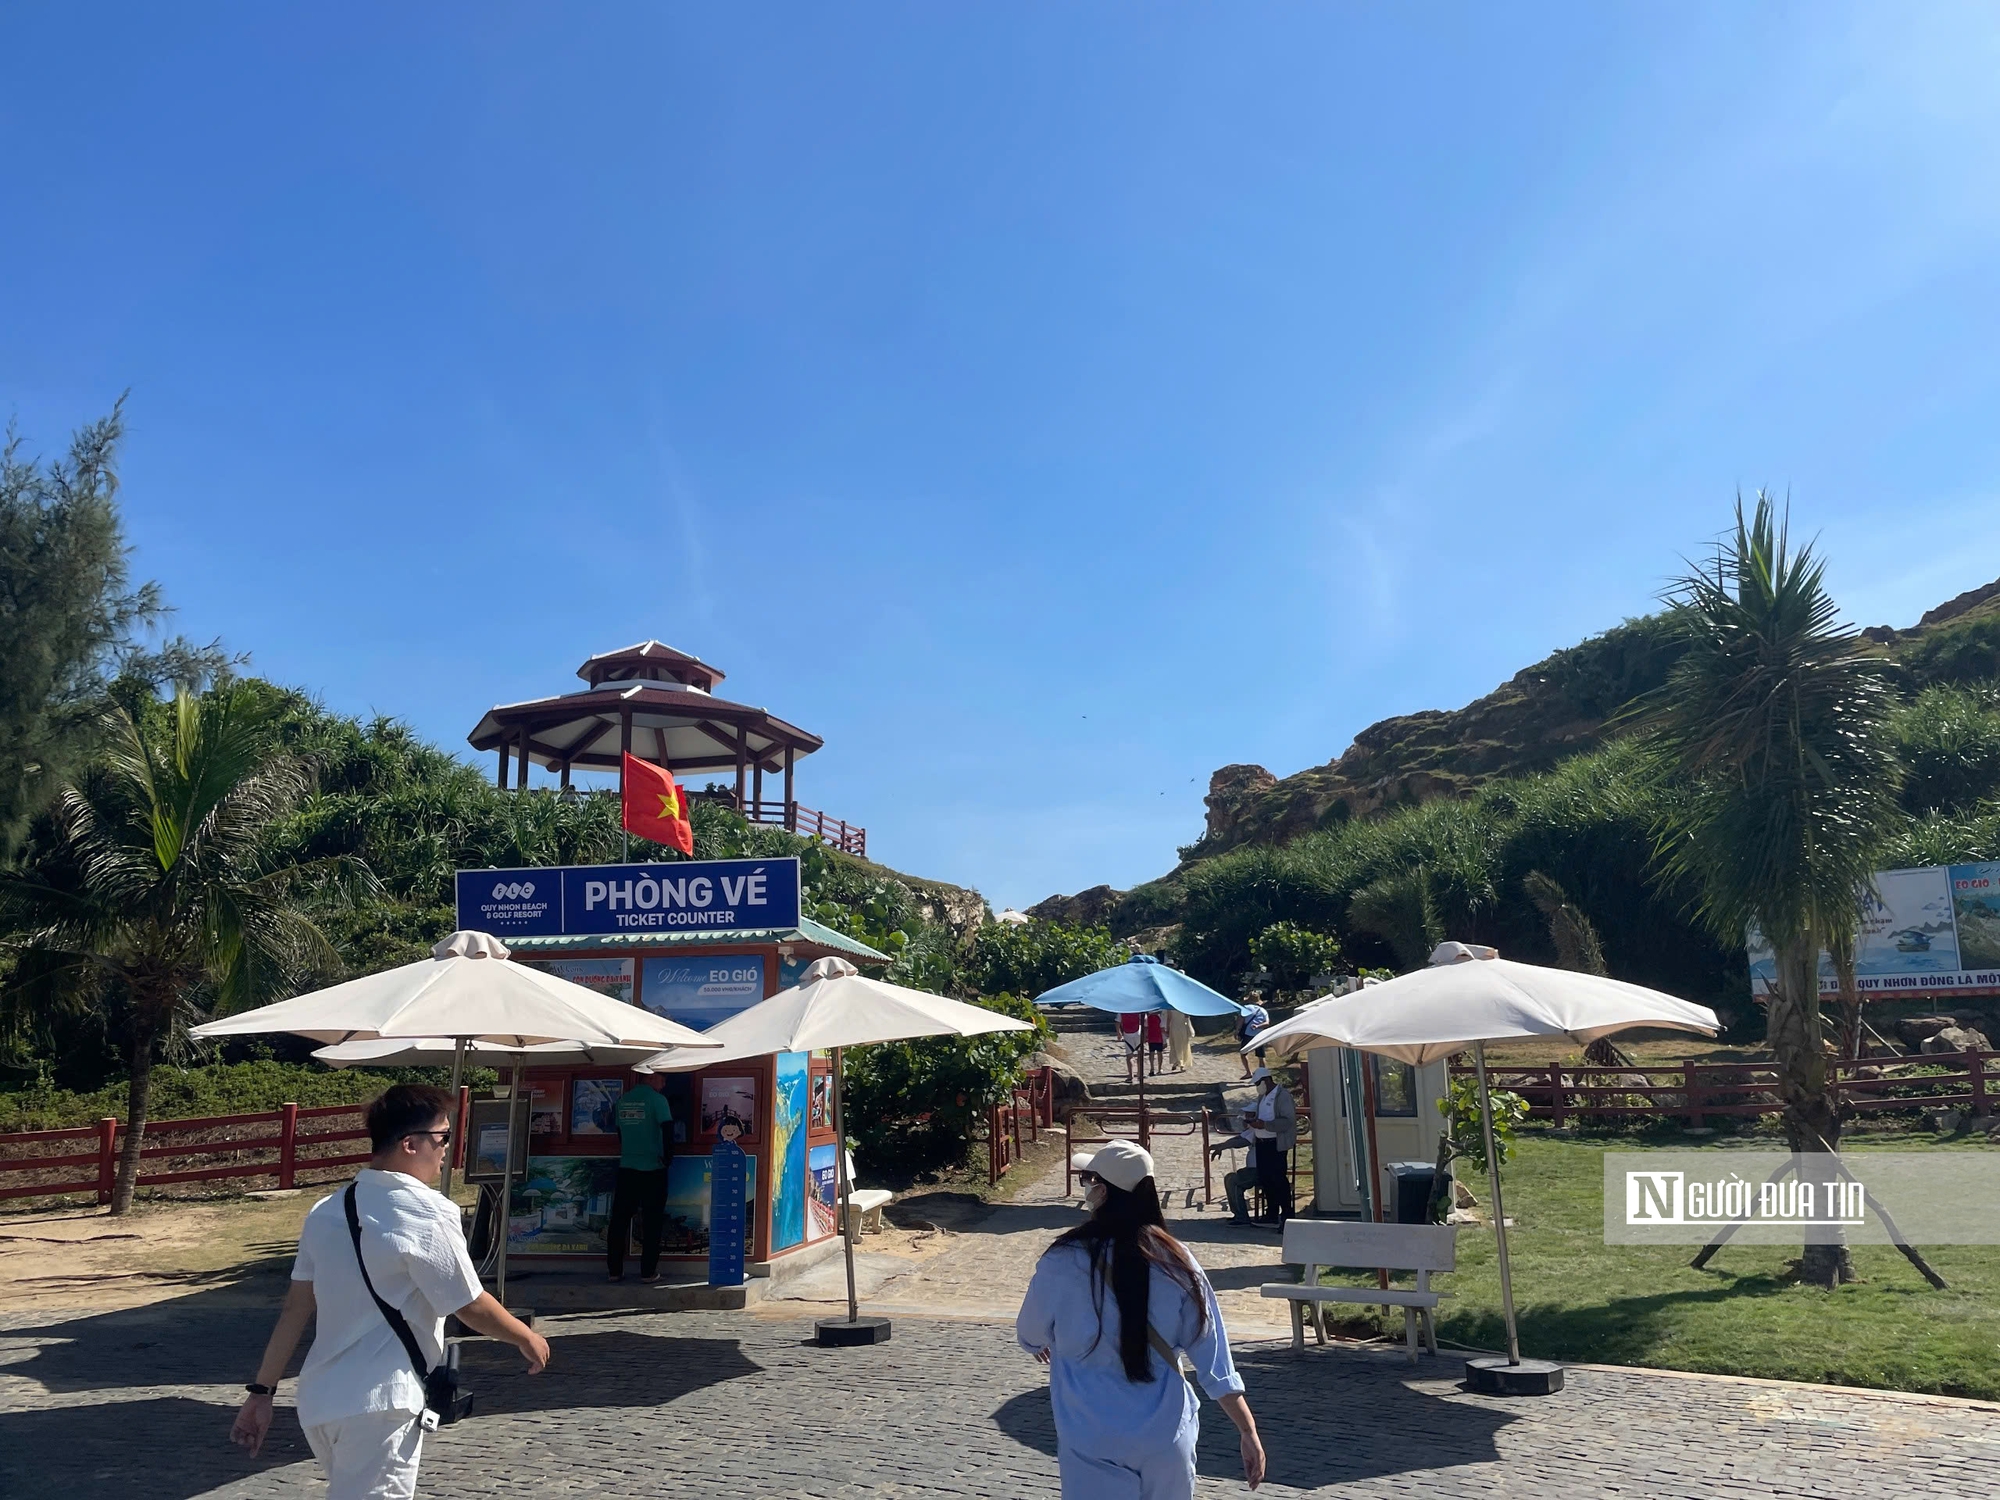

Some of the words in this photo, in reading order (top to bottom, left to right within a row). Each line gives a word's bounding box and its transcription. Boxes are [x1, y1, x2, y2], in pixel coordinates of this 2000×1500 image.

[585, 872, 713, 911] PHÒNG
[720, 867, 768, 906] VÉ
[498, 903, 520, 911] NHON
[616, 913, 665, 926] TICKET
[667, 911, 735, 925] COUNTER
[657, 968, 707, 984] Welcome
[710, 970, 729, 982] EO
[732, 966, 758, 982] GIÓ
[1858, 980, 1880, 989] QUY
[1884, 976, 1917, 988] NHƠN
[1921, 974, 1954, 986] ĐÔNG
[1958, 973, 1973, 985] LÀ
